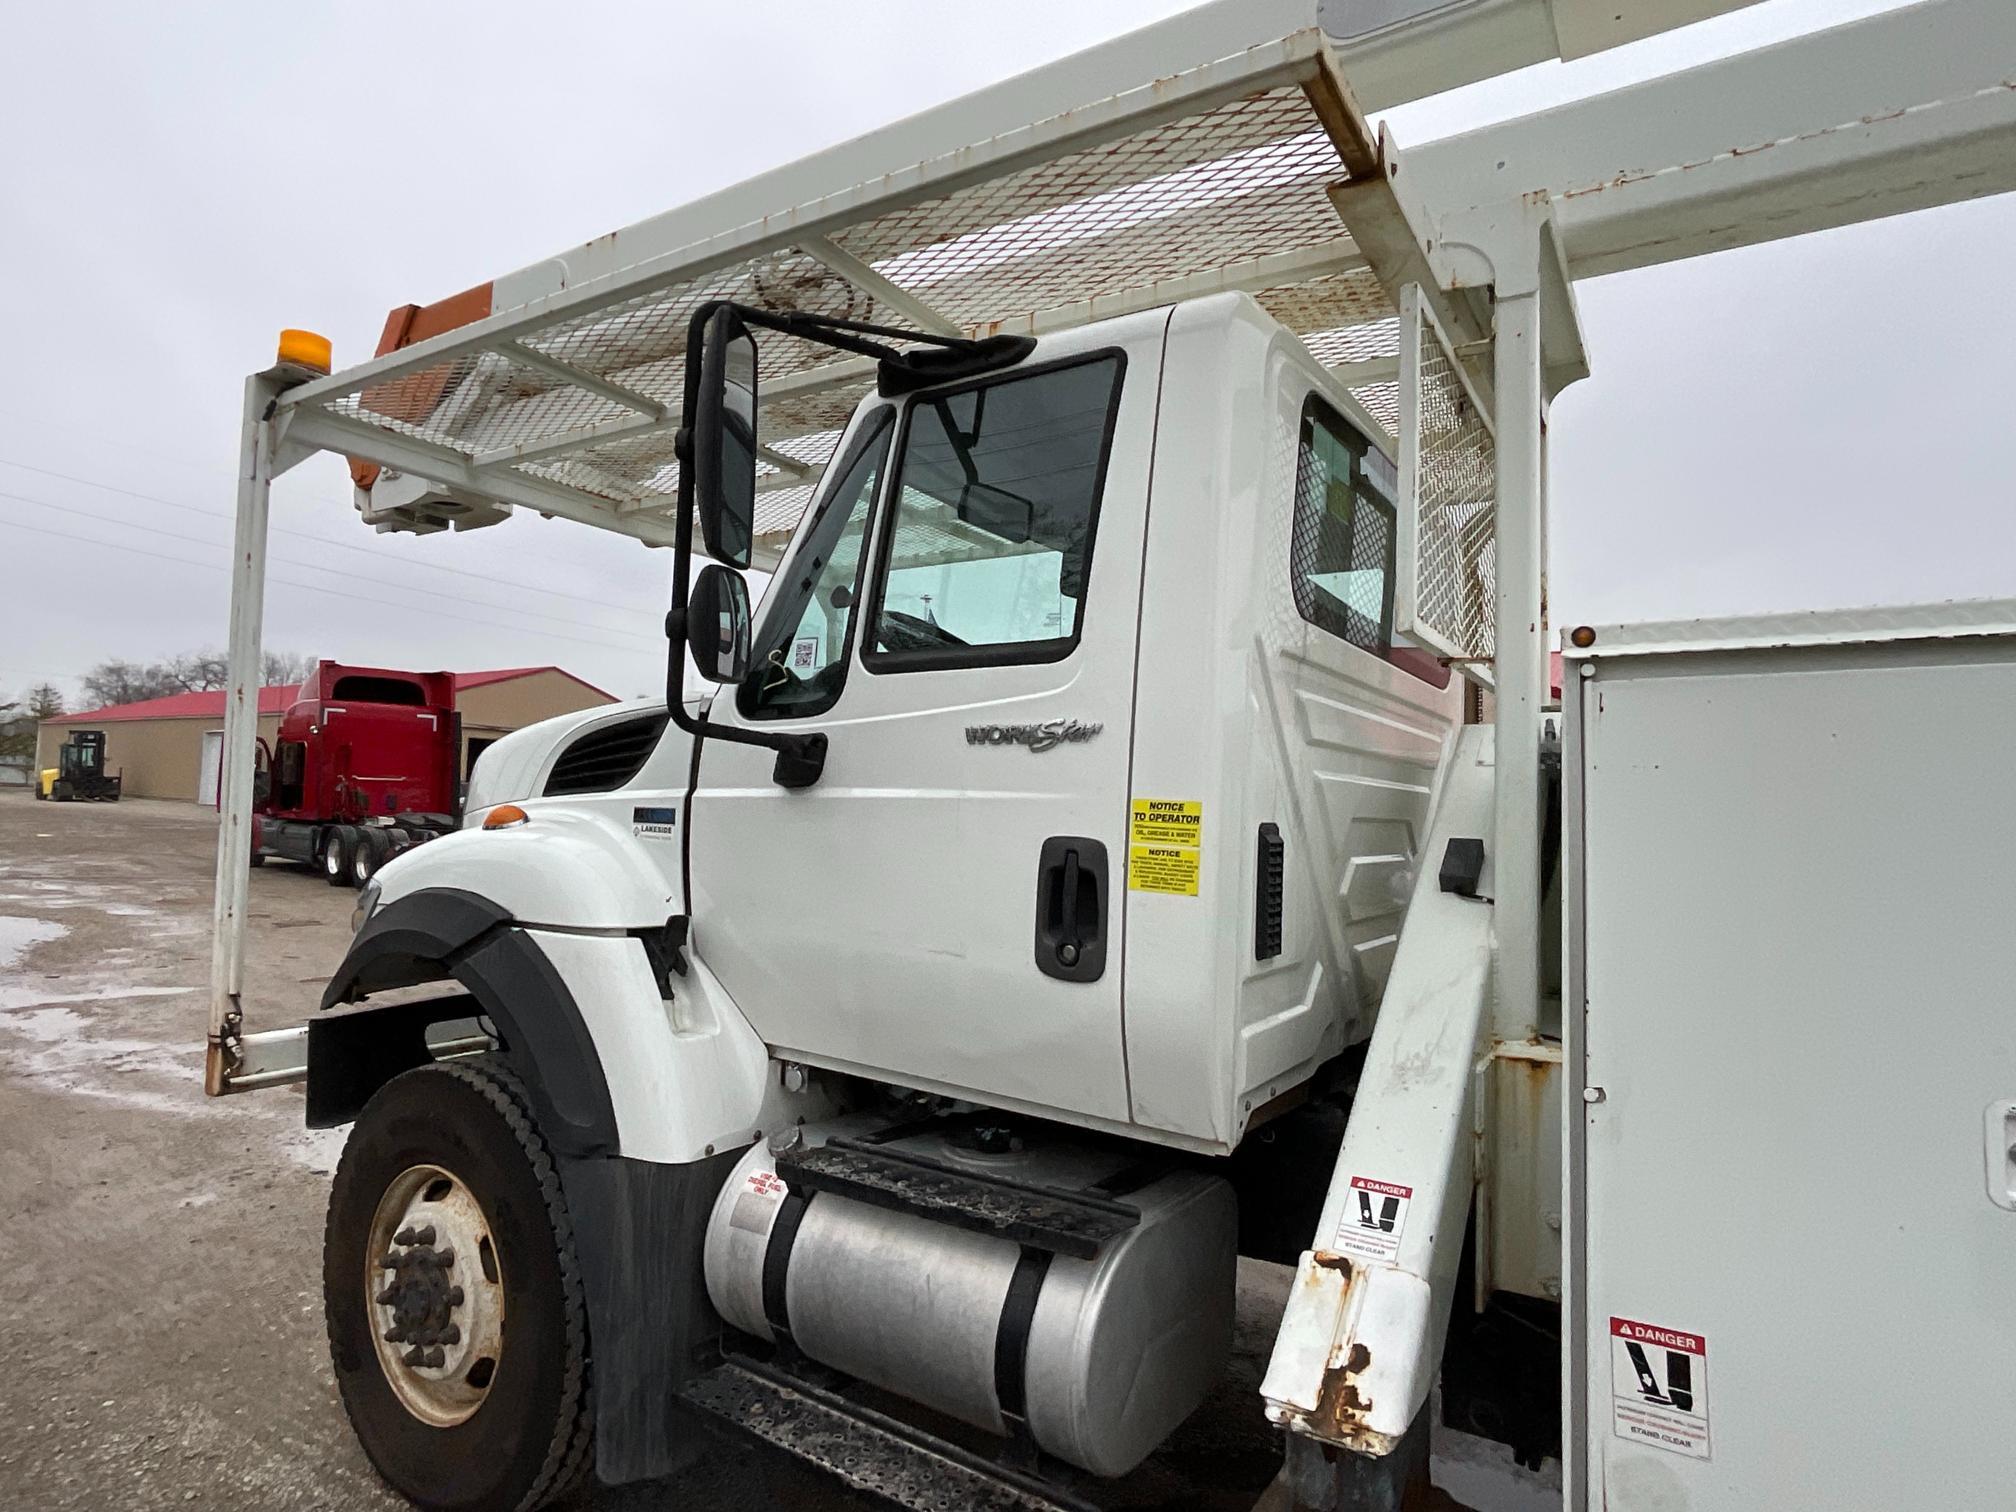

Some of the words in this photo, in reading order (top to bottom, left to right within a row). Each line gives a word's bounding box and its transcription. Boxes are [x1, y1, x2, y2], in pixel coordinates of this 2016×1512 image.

[1149, 802, 1185, 812] NOTICE
[1134, 812, 1146, 821] TO
[1149, 813, 1201, 824] OPERATOR
[1147, 830, 1169, 838] GREASE
[1148, 849, 1181, 858] NOTICE
[1367, 1183, 1406, 1196] DANGER
[1345, 1243, 1365, 1251] STAND
[1365, 1247, 1385, 1255] CLEAR
[1635, 1327, 1696, 1349] DANGER
[1631, 1426, 1660, 1439] STAND
[1661, 1435, 1692, 1448] CLEAR
